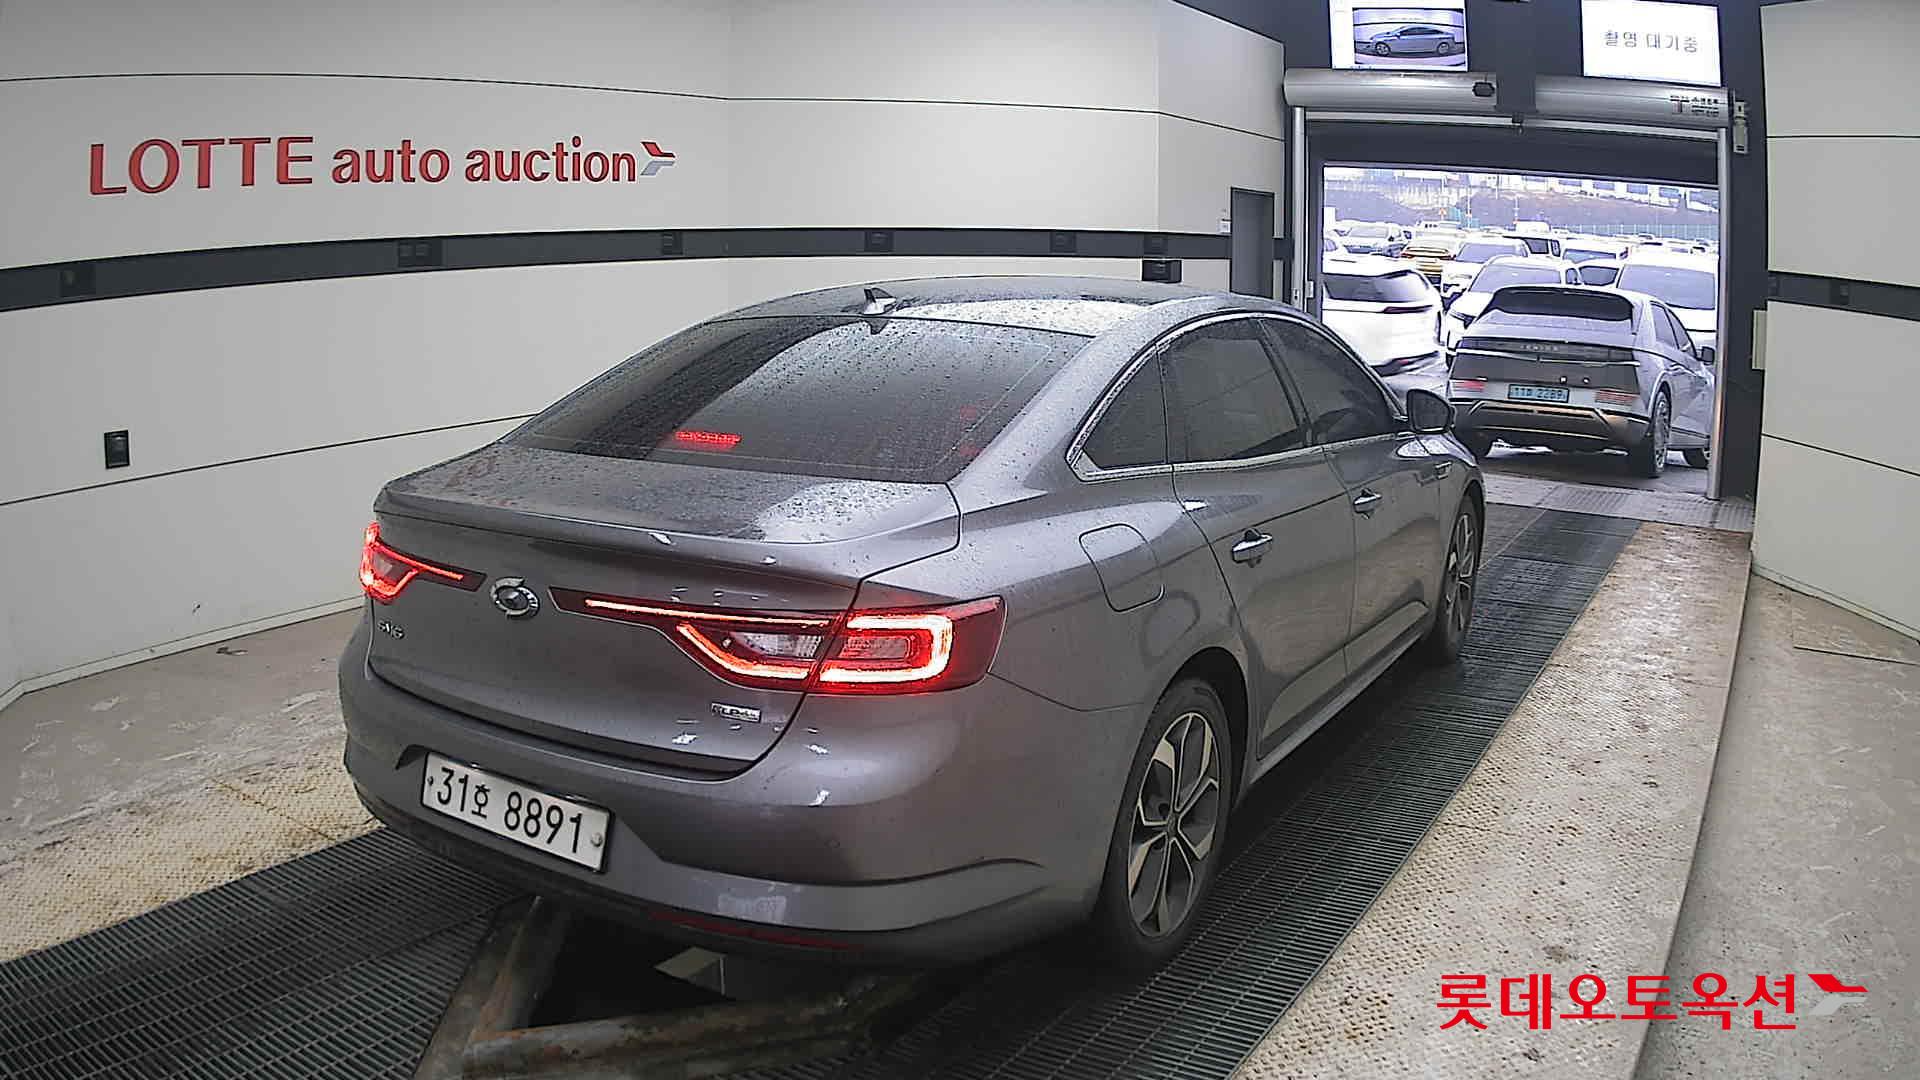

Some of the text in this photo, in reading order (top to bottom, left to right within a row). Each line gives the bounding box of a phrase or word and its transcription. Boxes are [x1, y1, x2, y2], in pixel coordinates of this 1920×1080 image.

[1604, 30, 1698, 53] 촬영 대기중
[90, 136, 636, 195] LOTTE auto auction
[436, 767, 584, 854] 31호 8891
